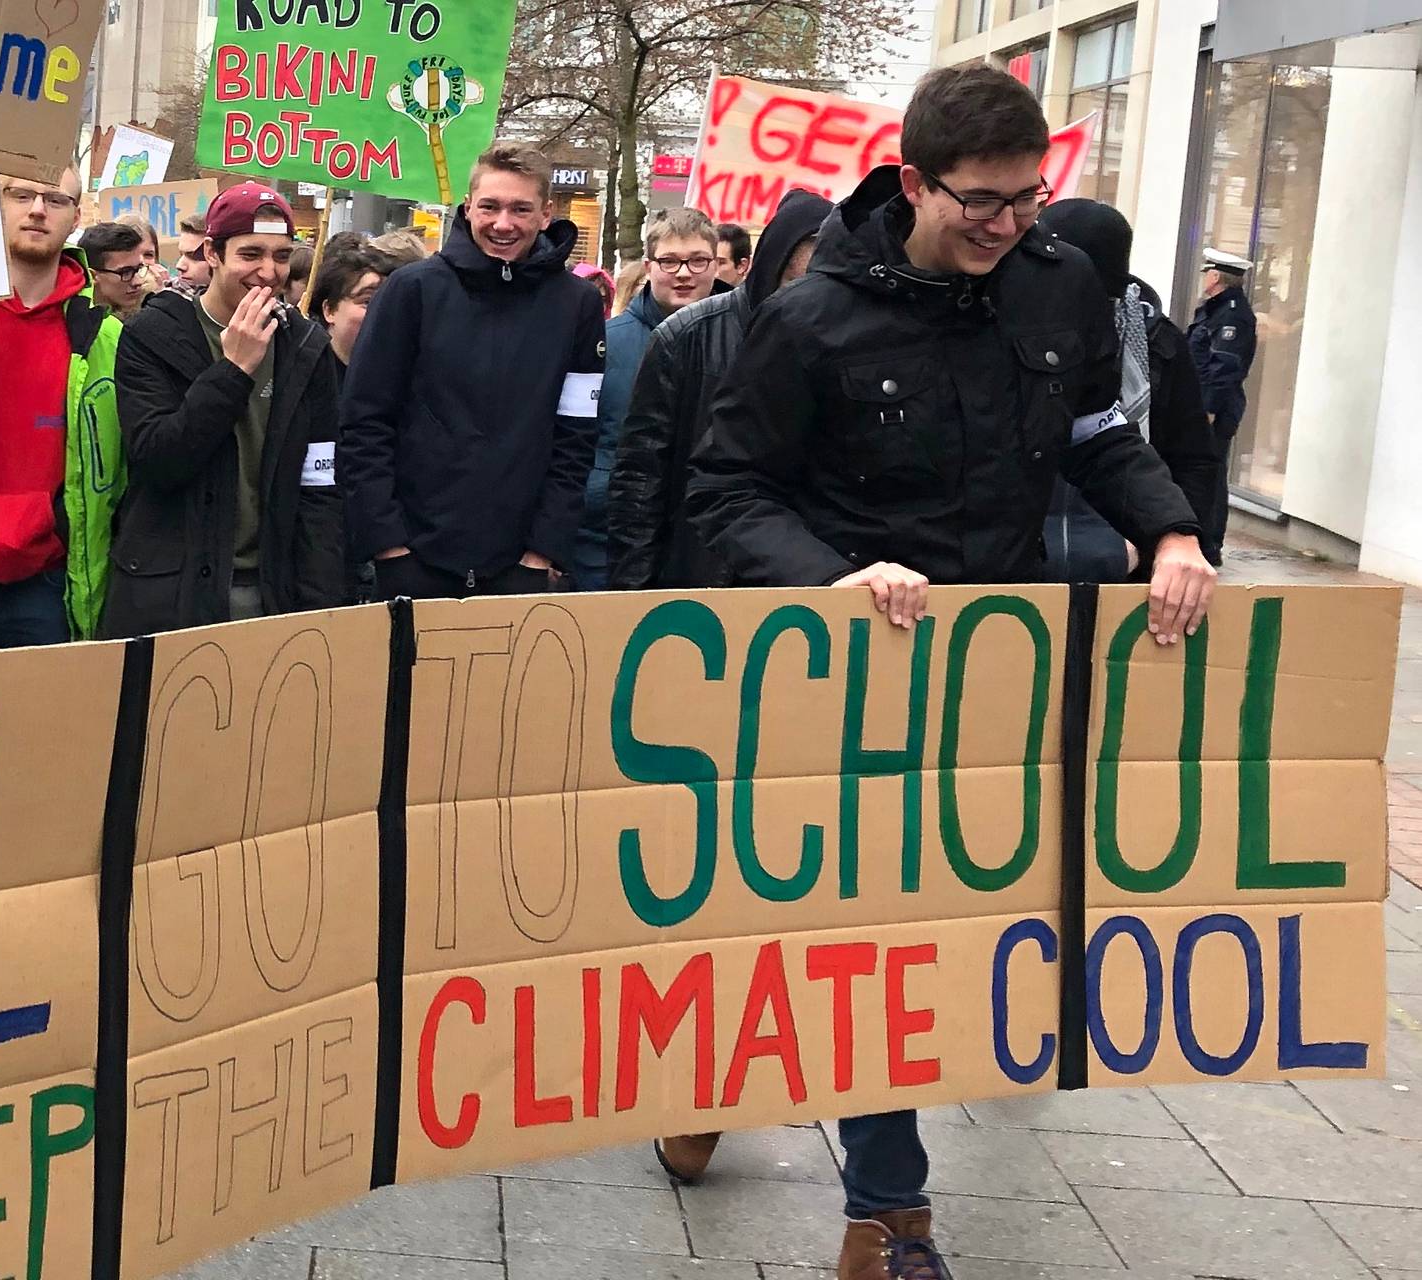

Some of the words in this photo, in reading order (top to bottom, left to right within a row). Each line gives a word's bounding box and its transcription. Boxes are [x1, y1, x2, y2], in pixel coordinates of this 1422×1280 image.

[385, 0, 441, 42] TO
[215, 43, 376, 107] BIKINI
[422, 56, 445, 70] FRI
[222, 111, 402, 182] BOTTOM
[551, 169, 587, 185] HRIST
[696, 160, 822, 226] KLIM
[133, 626, 334, 1023] GO
[415, 602, 586, 951] TO
[611, 594, 1347, 929] SCHOOL
[134, 1016, 354, 1246] THE
[418, 940, 940, 1149] CLIMATE
[991, 913, 1369, 1086] COOL
